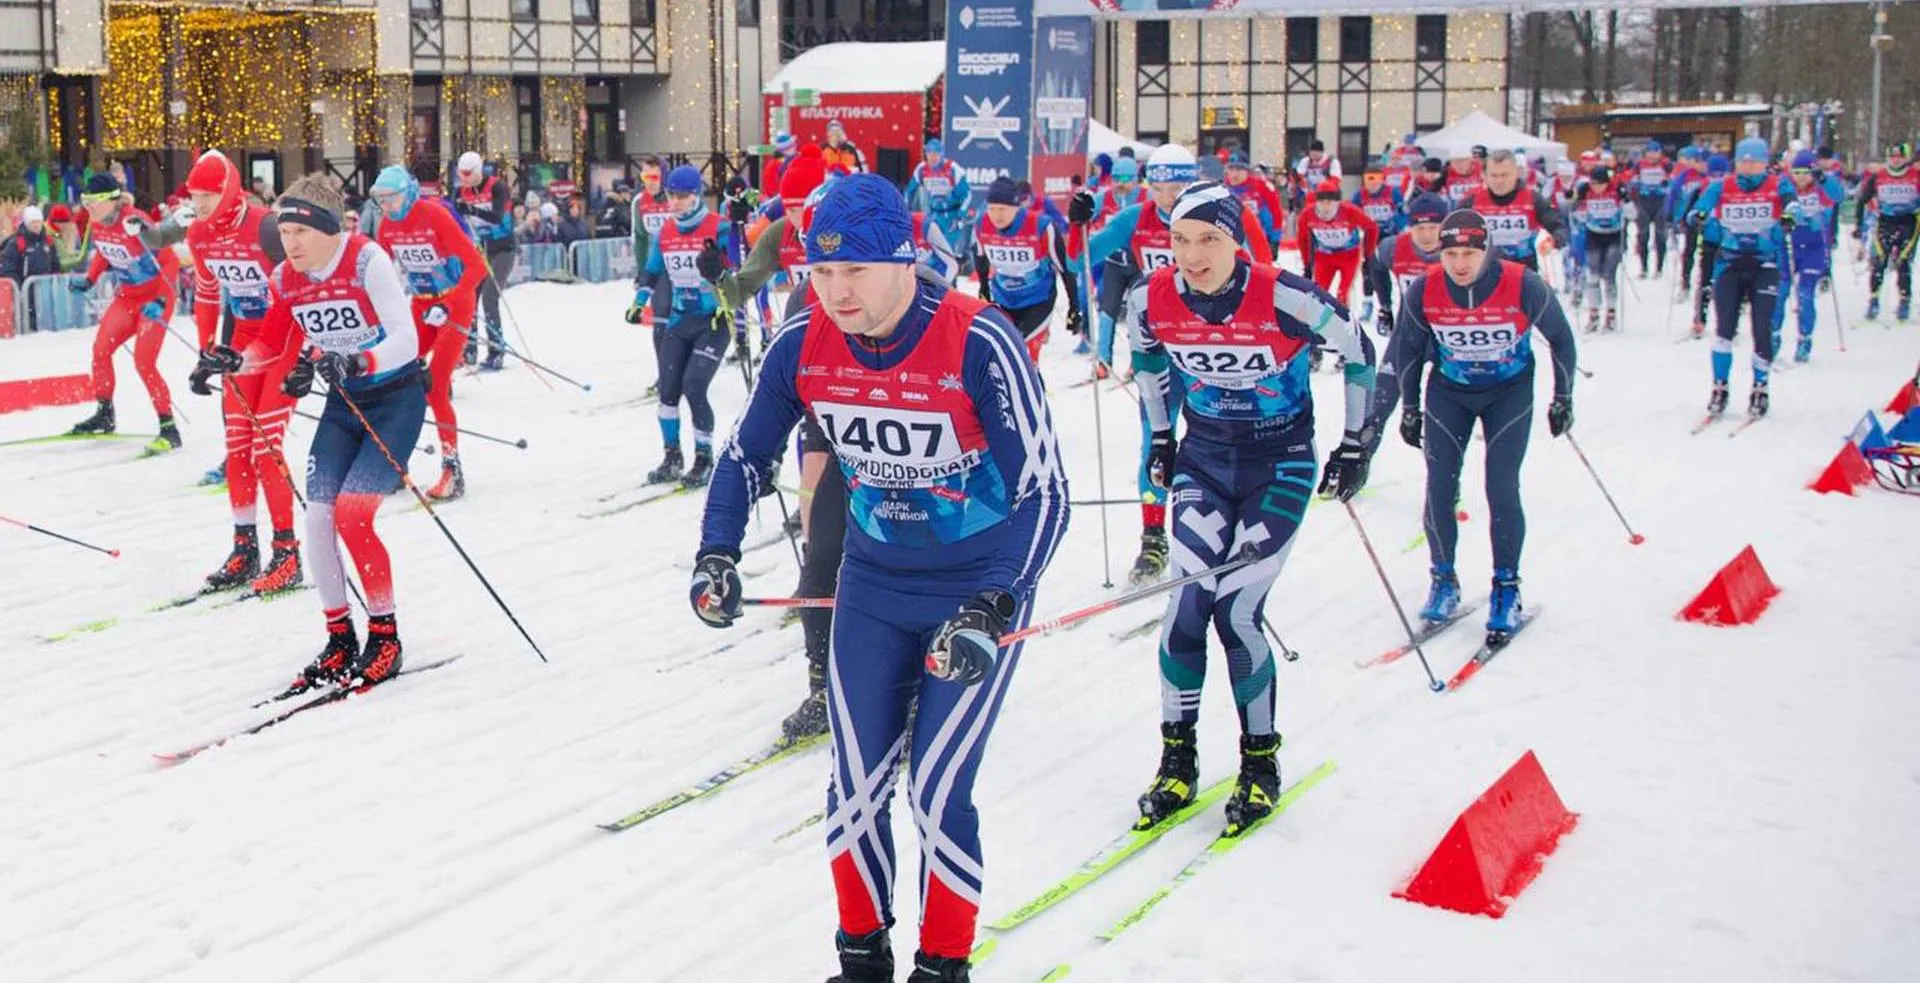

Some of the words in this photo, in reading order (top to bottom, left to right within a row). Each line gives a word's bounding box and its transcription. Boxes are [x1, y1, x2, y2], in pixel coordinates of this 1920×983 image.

[1725, 206, 1770, 219] 1393
[989, 249, 1030, 262] 1318
[297, 307, 360, 333] 1328
[1172, 351, 1271, 373] 1324
[821, 413, 943, 458] 1407
